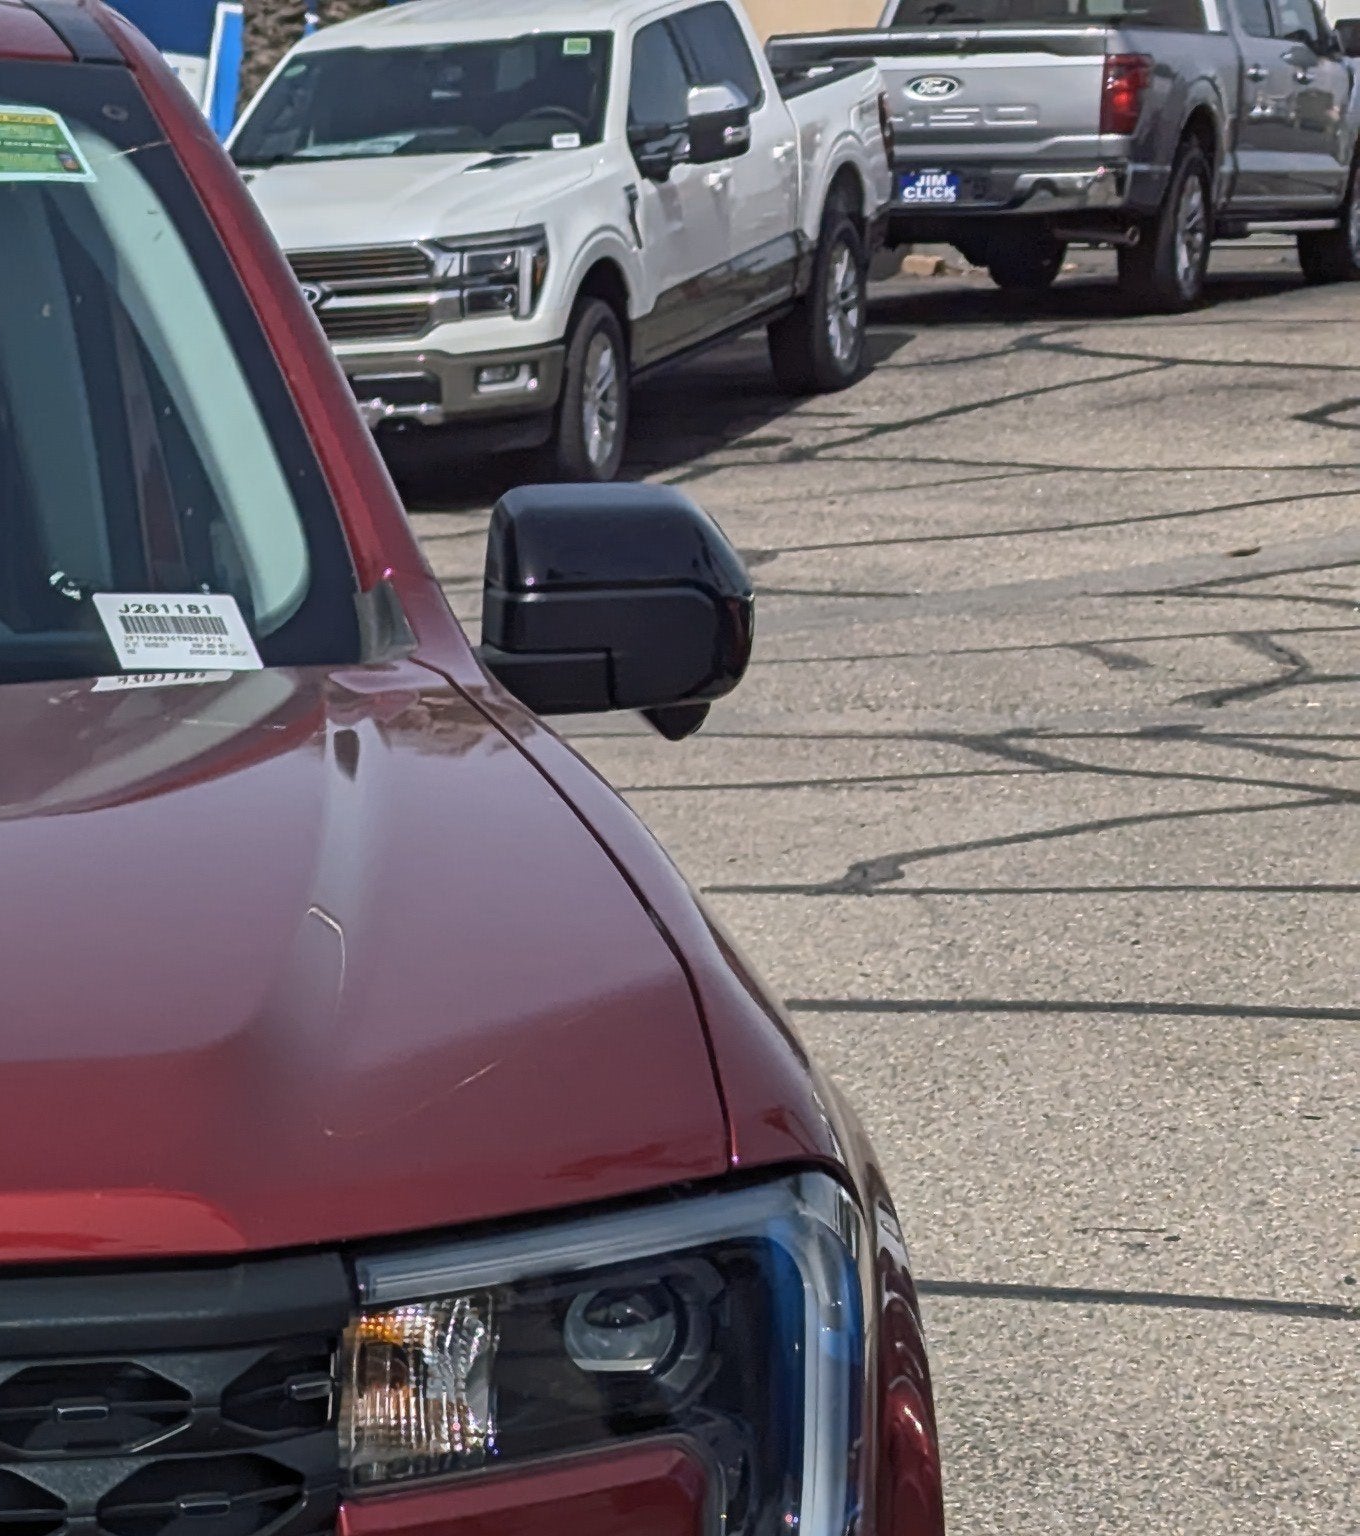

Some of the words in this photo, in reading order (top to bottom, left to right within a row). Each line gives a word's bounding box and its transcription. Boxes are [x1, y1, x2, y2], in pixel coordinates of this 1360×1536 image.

[915, 174, 947, 187] JIM
[902, 186, 957, 199] CLICK
[118, 603, 212, 615] J261181
